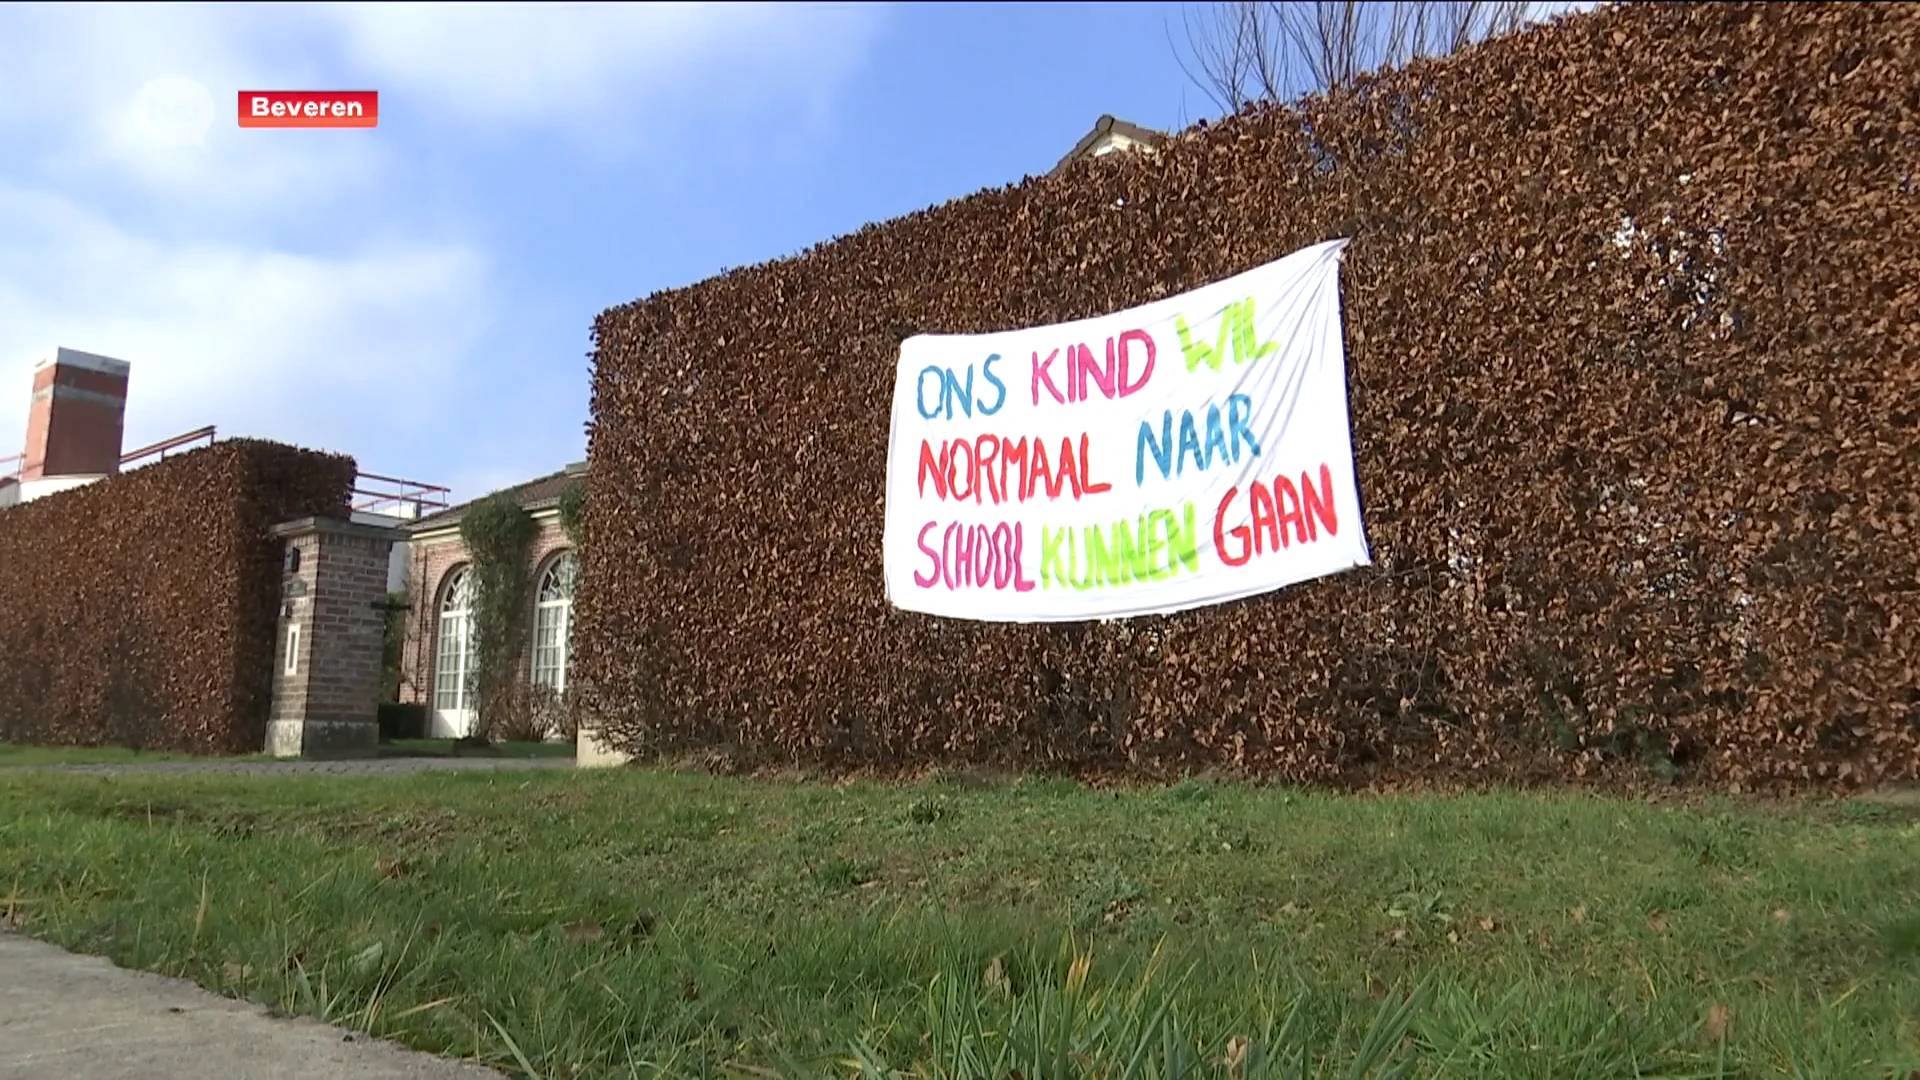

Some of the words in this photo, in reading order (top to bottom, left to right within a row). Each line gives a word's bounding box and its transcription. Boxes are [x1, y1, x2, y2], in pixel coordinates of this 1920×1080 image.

[917, 353, 1007, 420] ONS
[1031, 329, 1156, 405] KIND
[1176, 296, 1279, 373] WIL
[917, 432, 1112, 504] NORMAAL
[1136, 393, 1260, 486] NAAR
[914, 521, 1035, 592] SCHOOL
[1041, 502, 1199, 591] KUNNEN
[1213, 463, 1338, 567] GAAN
